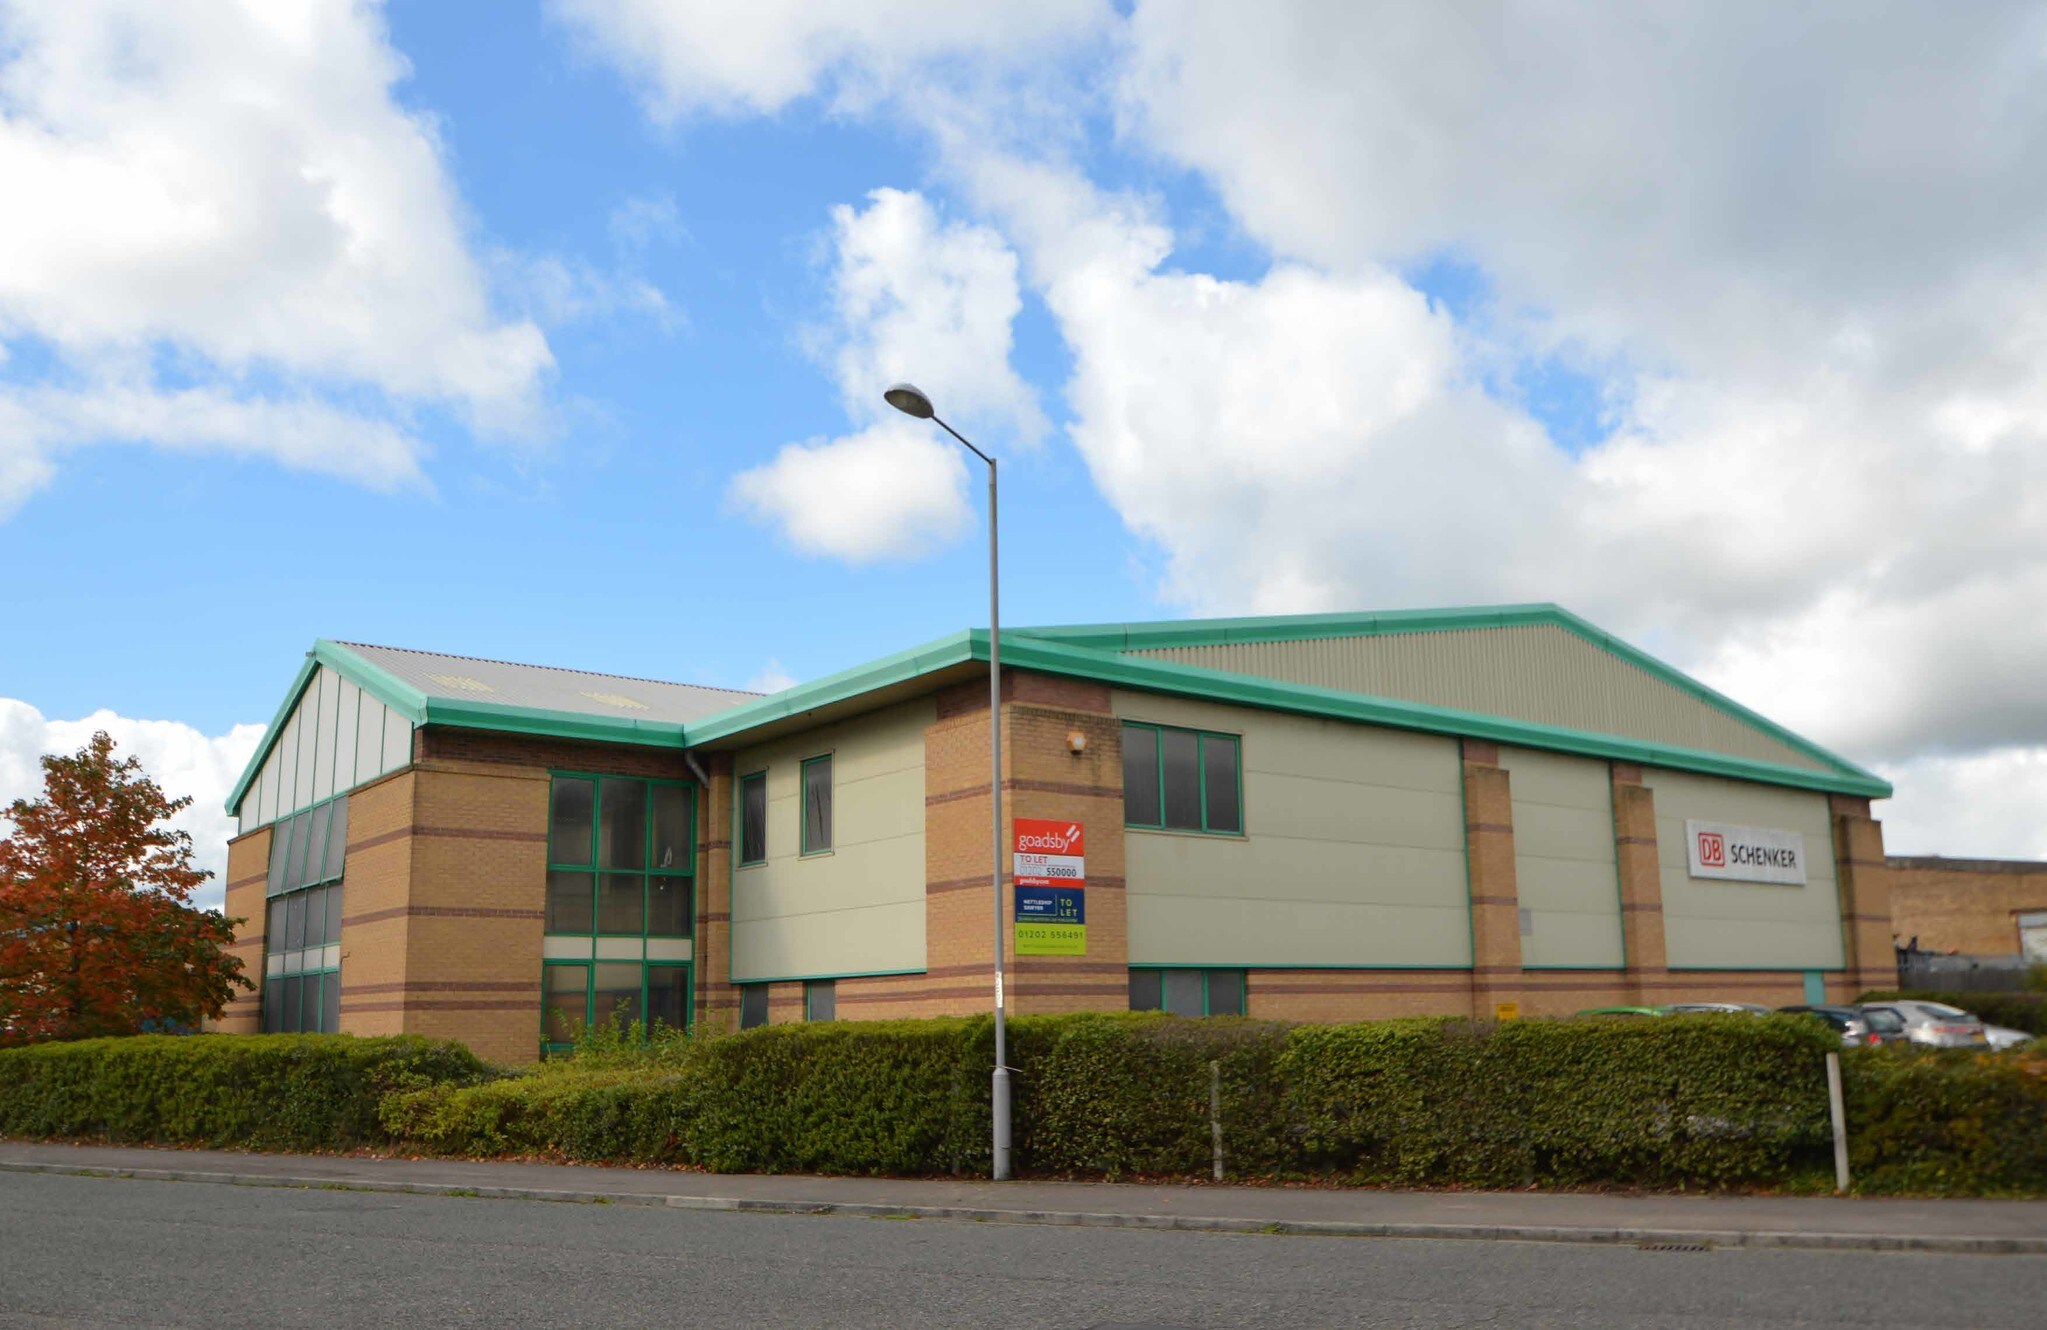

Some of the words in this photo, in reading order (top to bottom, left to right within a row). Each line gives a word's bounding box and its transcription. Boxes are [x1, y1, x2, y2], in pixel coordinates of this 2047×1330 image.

[1019, 832, 1069, 853] goadsby
[1701, 837, 1722, 862] DB
[1731, 844, 1797, 869] SCHENKER
[1020, 855, 1032, 863] TO
[1033, 856, 1048, 864] LET
[1046, 867, 1077, 877] 550000
[1060, 898, 1072, 907] TO
[1060, 909, 1078, 917] LET
[1018, 930, 1046, 938] 01202
